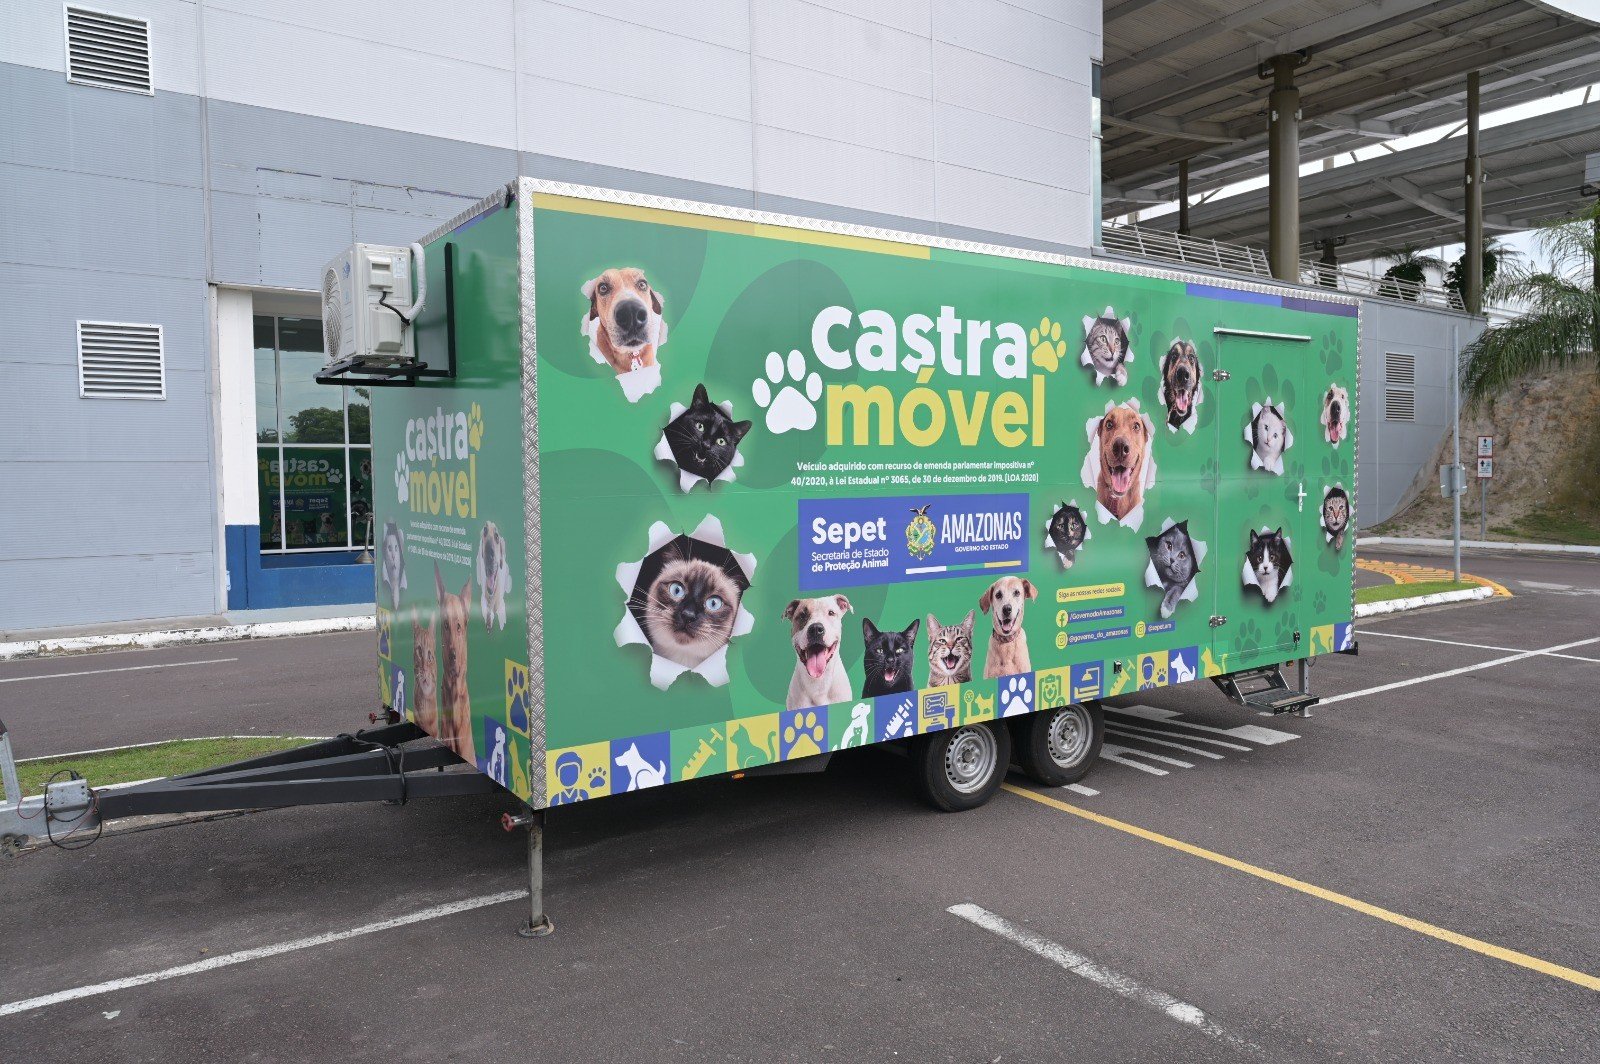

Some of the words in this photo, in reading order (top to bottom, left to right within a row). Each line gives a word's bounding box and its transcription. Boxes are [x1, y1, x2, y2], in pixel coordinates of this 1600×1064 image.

[826, 367, 1045, 447] móvel
[796, 461, 828, 471] Veículo
[828, 461, 867, 472] adquirido
[885, 462, 912, 470] recurso
[912, 461, 923, 470] de
[923, 461, 952, 470] emenda
[952, 461, 993, 471] parlamentar
[993, 461, 1027, 471] impositiva
[409, 454, 477, 519] móvel
[790, 476, 828, 487] 40/2020,
[829, 476, 834, 486] à
[835, 476, 847, 486] Lei
[847, 475, 880, 485] Estadual
[890, 475, 911, 485] 3065,
[912, 475, 922, 484] de
[922, 475, 932, 483] 30
[932, 475, 942, 483] de
[942, 474, 977, 483] dezembro
[977, 474, 987, 482] de
[811, 516, 887, 550] Sepet
[940, 511, 1022, 544] AMAZONAS
[811, 549, 850, 561] Secretaria
[851, 548, 863, 559] de
[864, 547, 889, 558] Estado
[954, 545, 981, 553] GOVERNO
[989, 543, 1009, 551] ESTADO
[811, 562, 823, 573] de
[824, 559, 861, 573] Proteção
[861, 557, 889, 569] Animal
